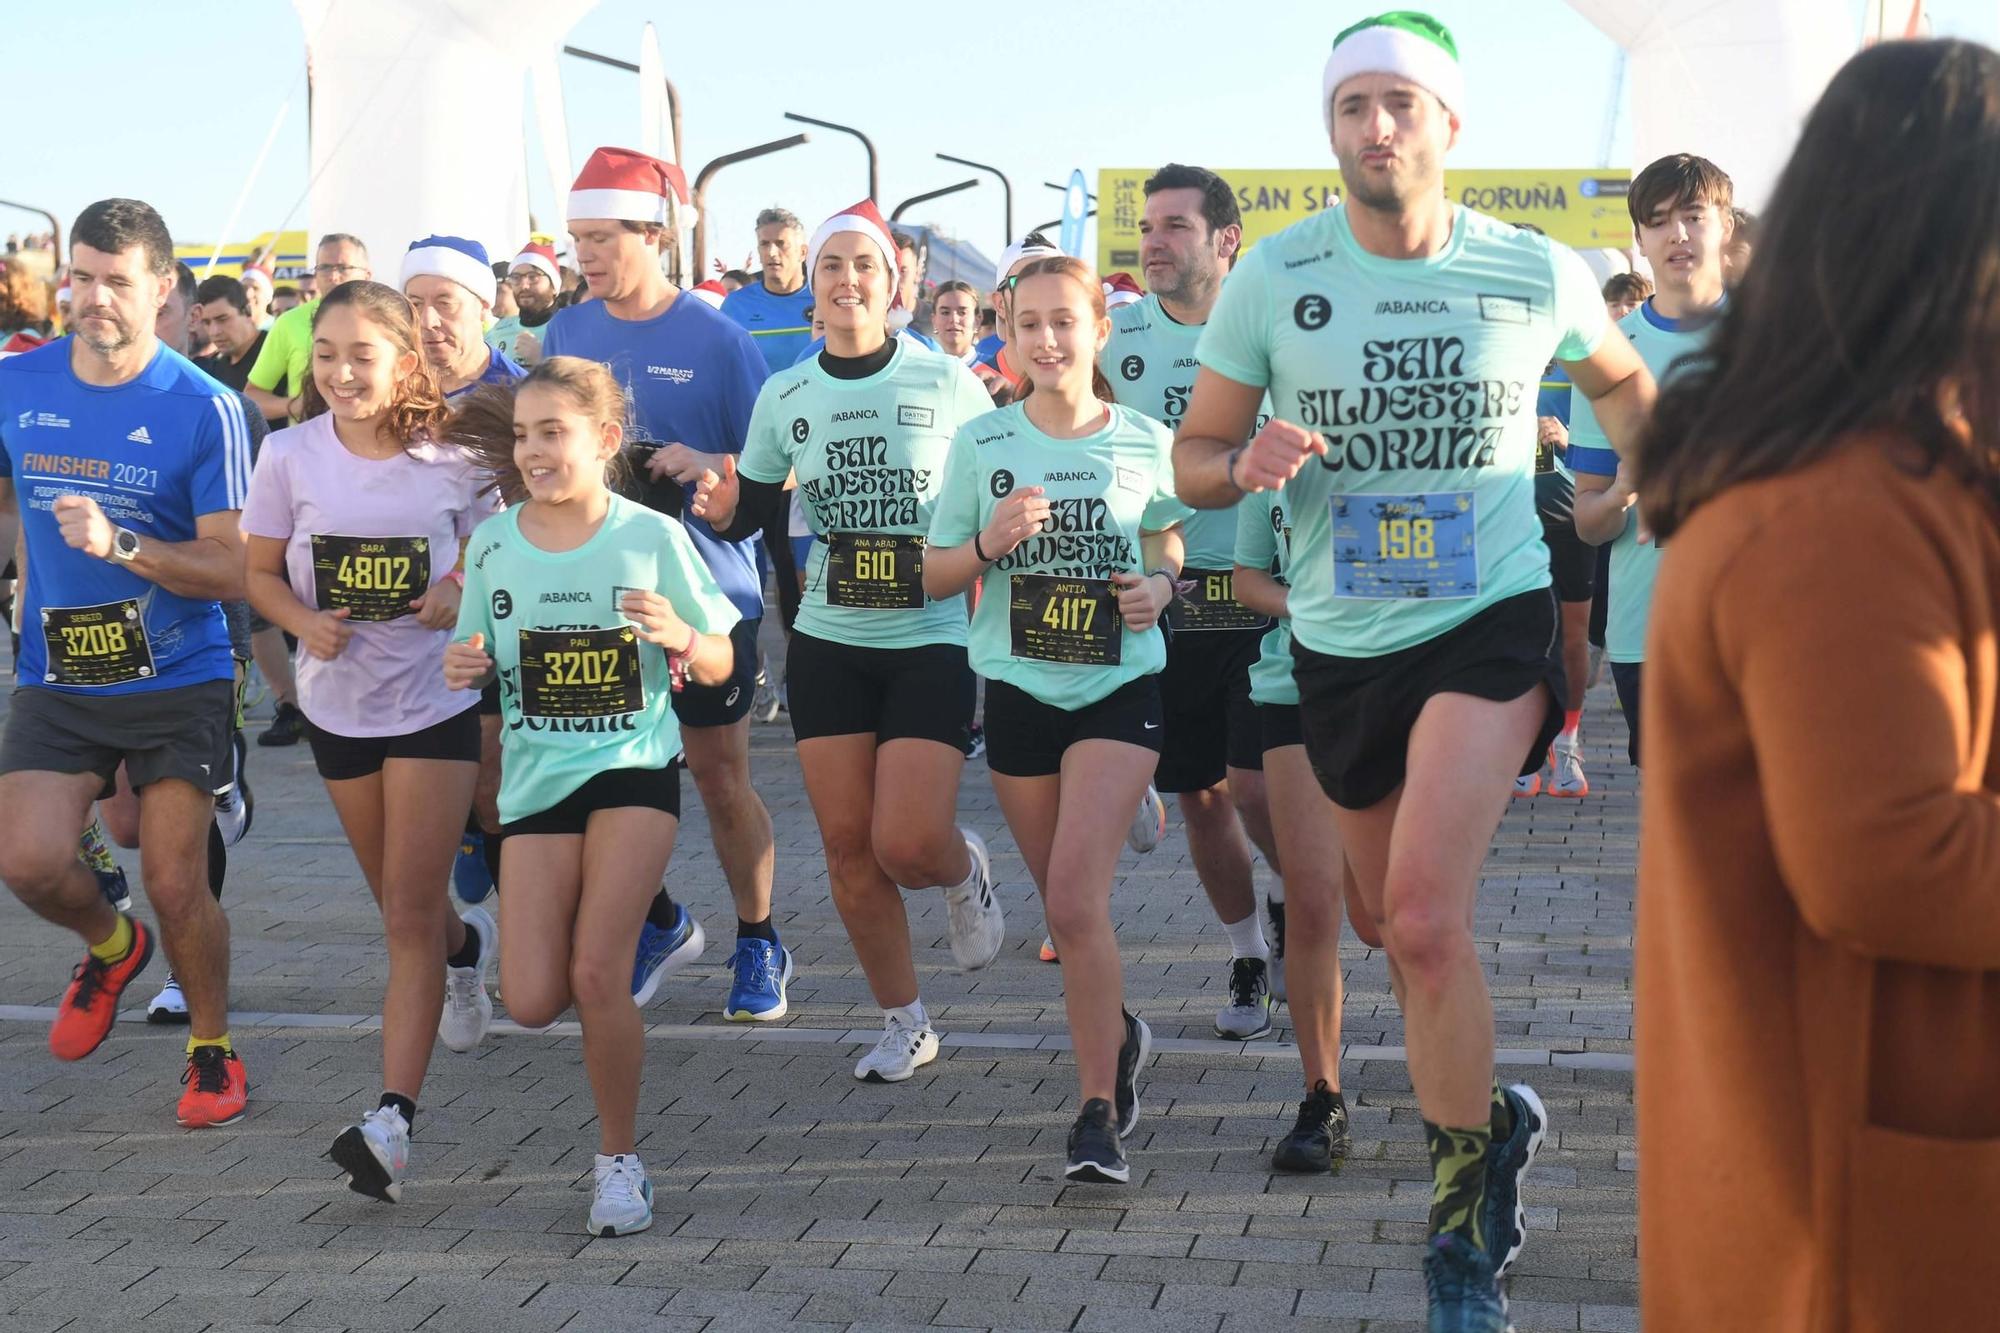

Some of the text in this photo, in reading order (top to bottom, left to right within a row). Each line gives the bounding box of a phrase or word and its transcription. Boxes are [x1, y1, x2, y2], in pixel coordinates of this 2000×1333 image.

[1238, 186, 1291, 212] SAN
[1461, 182, 1568, 210] CORUÑA
[1363, 336, 1465, 383] SAN
[1297, 380, 1525, 428] SILVESTRE
[22, 452, 158, 488] FINISHER 2021
[826, 435, 888, 471] SAN
[360, 543, 385, 553] SARA
[854, 539, 897, 548] ANA ABAD
[1378, 519, 1435, 560] 198
[337, 555, 411, 590] 4802
[855, 550, 895, 581] 610
[70, 612, 103, 623] SERGIO
[1042, 596, 1097, 632] 4117
[60, 621, 128, 657] 3208
[570, 638, 590, 648] PAU
[544, 649, 621, 686] 3202
